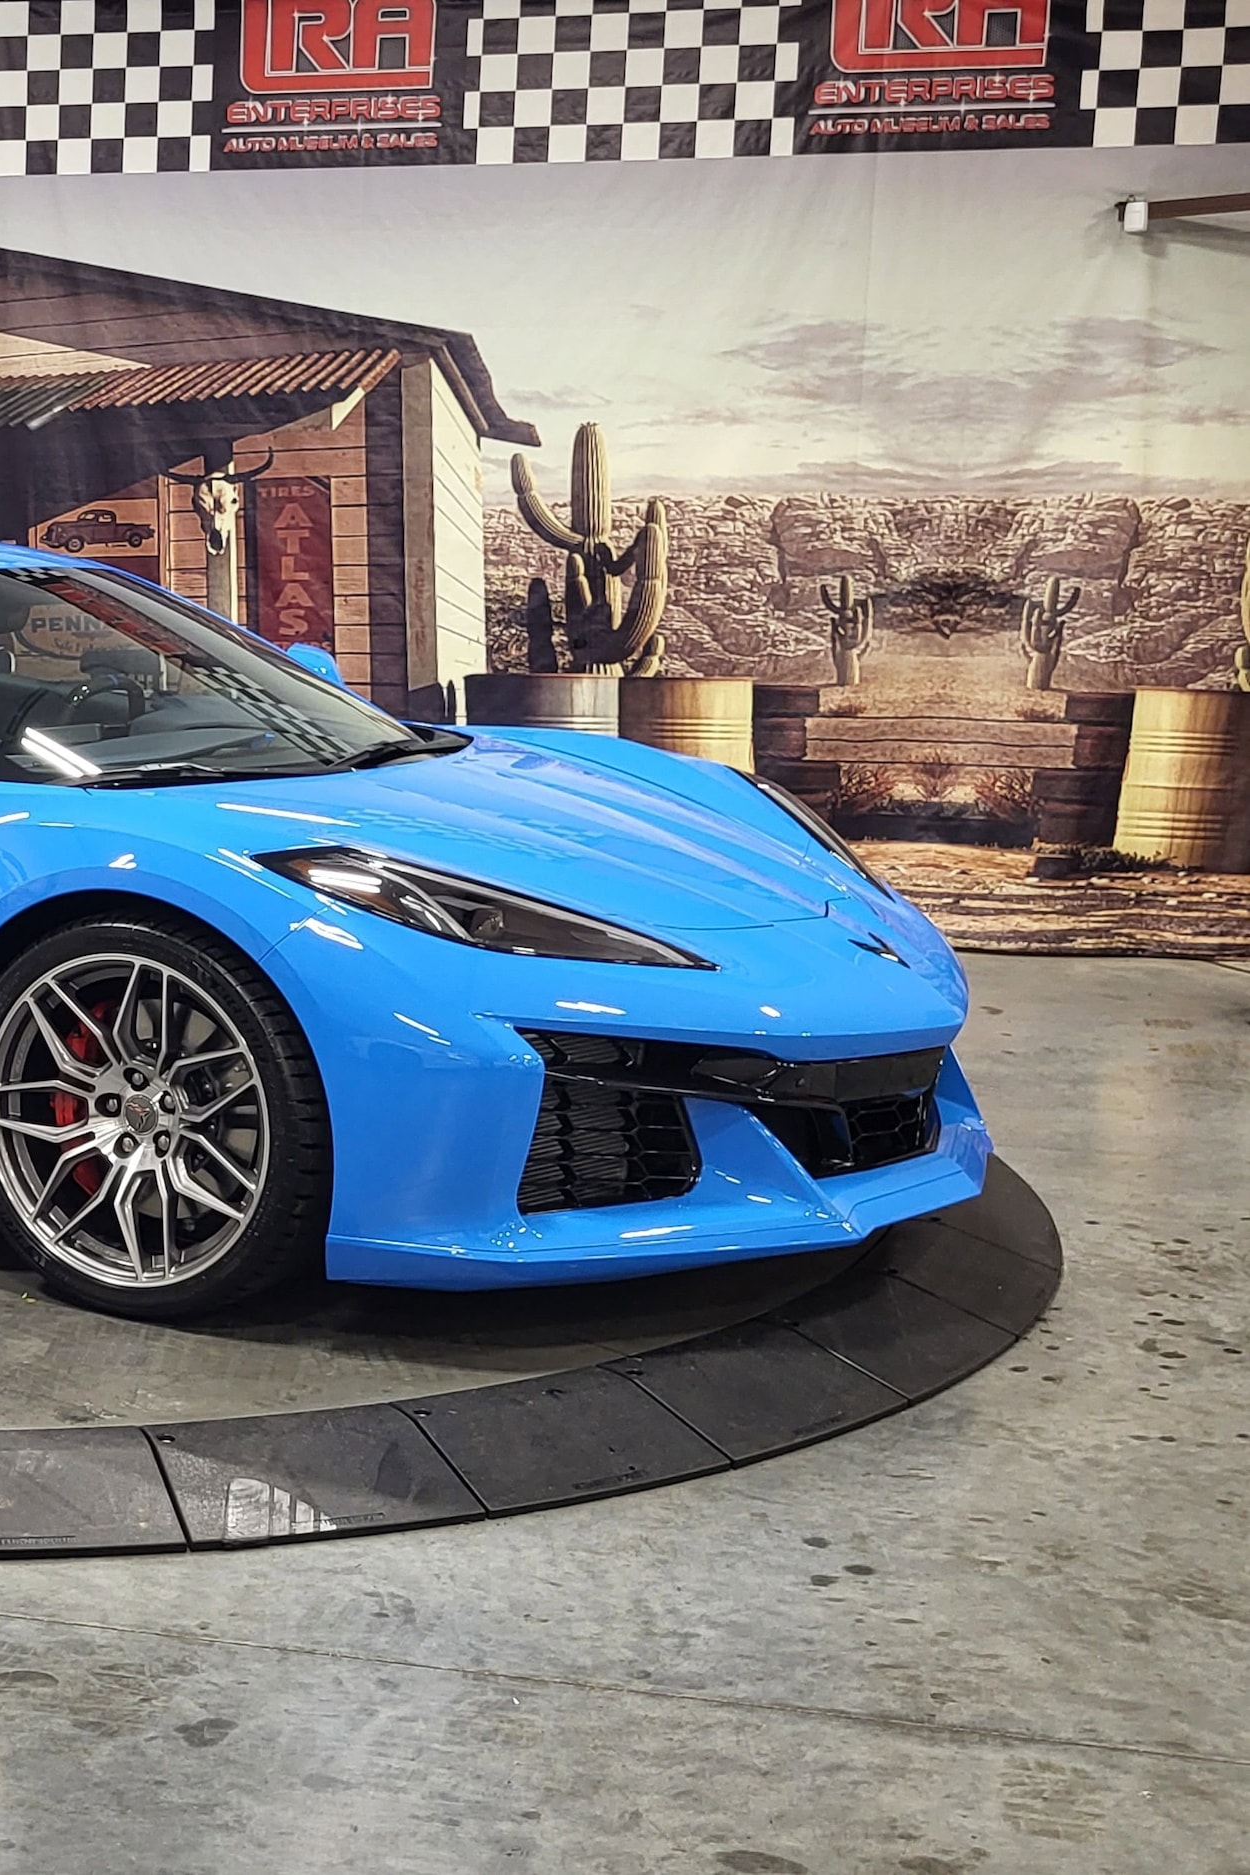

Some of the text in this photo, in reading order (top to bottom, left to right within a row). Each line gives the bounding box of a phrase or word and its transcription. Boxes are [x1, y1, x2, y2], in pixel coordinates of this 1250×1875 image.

[240, 0, 437, 94] LRA
[814, 74, 1055, 105] ENTERPRISES
[226, 95, 441, 123] ENTERPRISES
[810, 119, 868, 135] AUTO
[870, 116, 961, 134] MUSEUM
[981, 113, 1050, 130] SALES
[223, 137, 276, 152] AUTO
[277, 135, 359, 151] MUSEUM
[376, 132, 439, 149] SALES
[258, 485, 316, 498] TIRES
[273, 502, 314, 636] ATLAS
